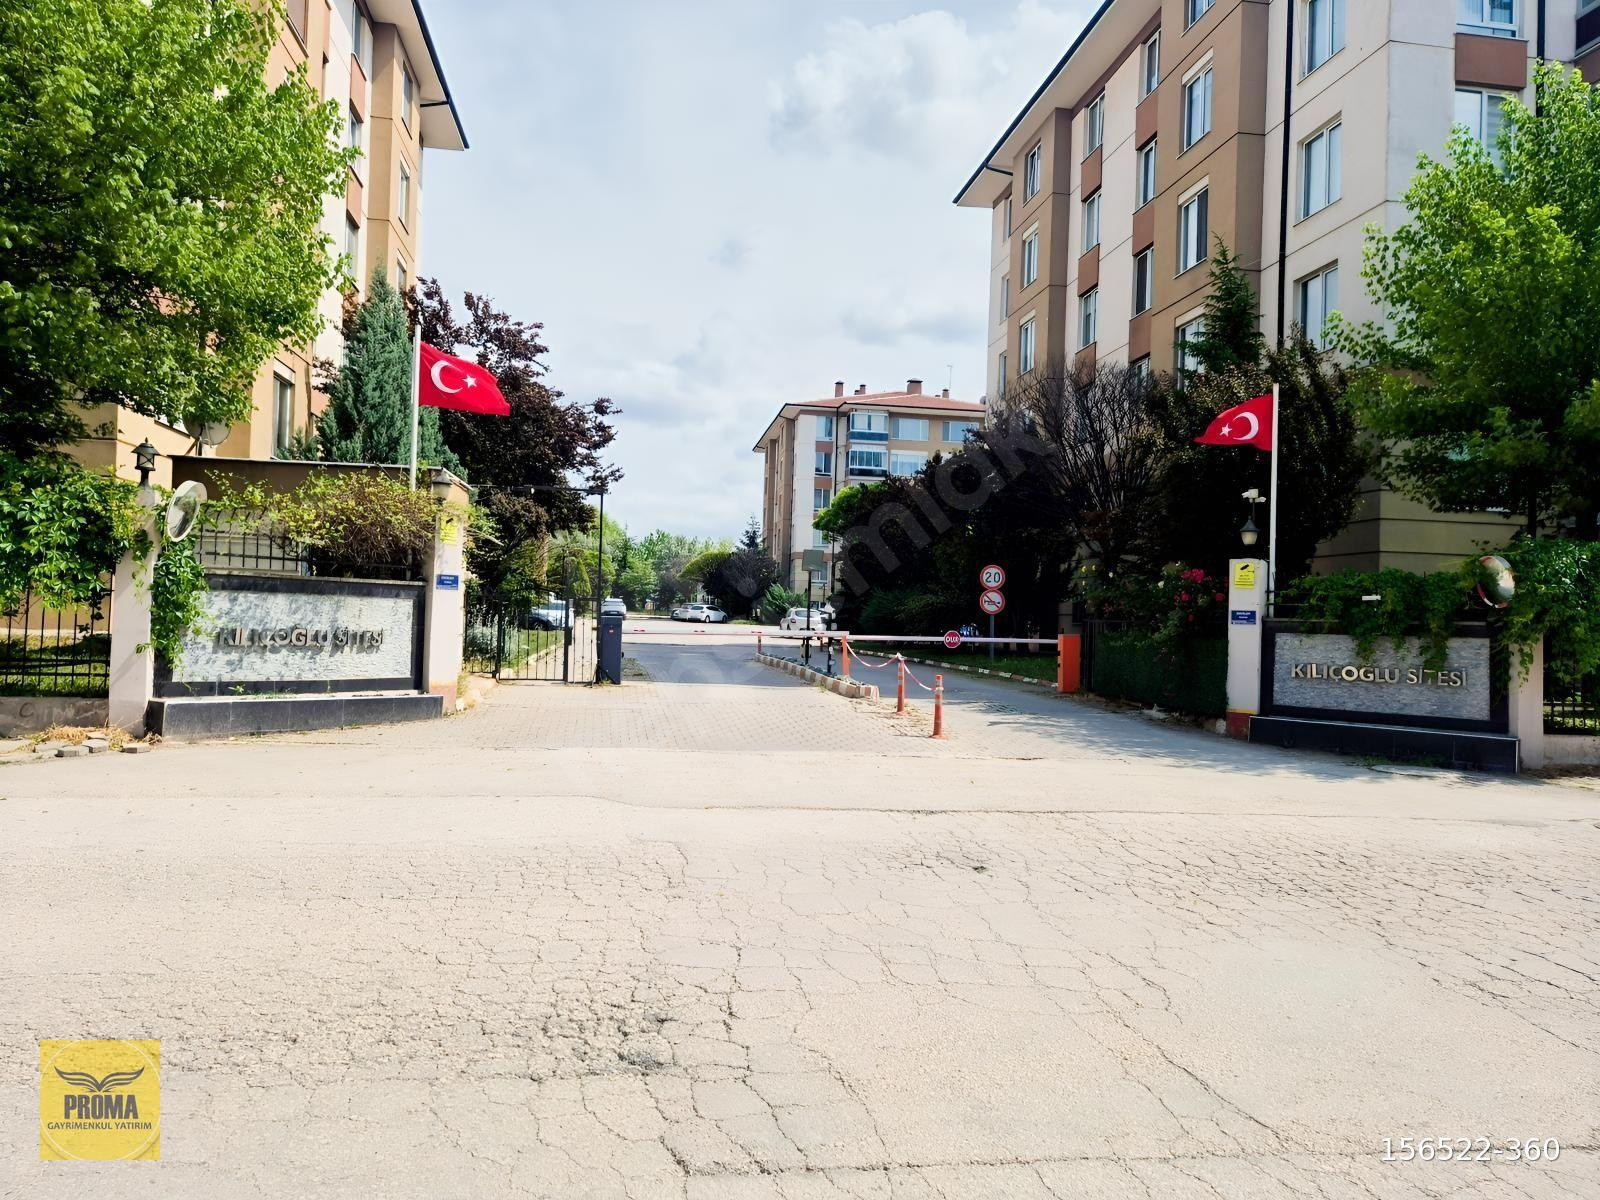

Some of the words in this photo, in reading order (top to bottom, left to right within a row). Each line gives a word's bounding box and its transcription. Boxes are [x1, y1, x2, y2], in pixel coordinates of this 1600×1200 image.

[985, 571, 1001, 583] 20
[1291, 661, 1400, 684] KILIÇOĞLU
[1406, 665, 1468, 687] SİTESİ
